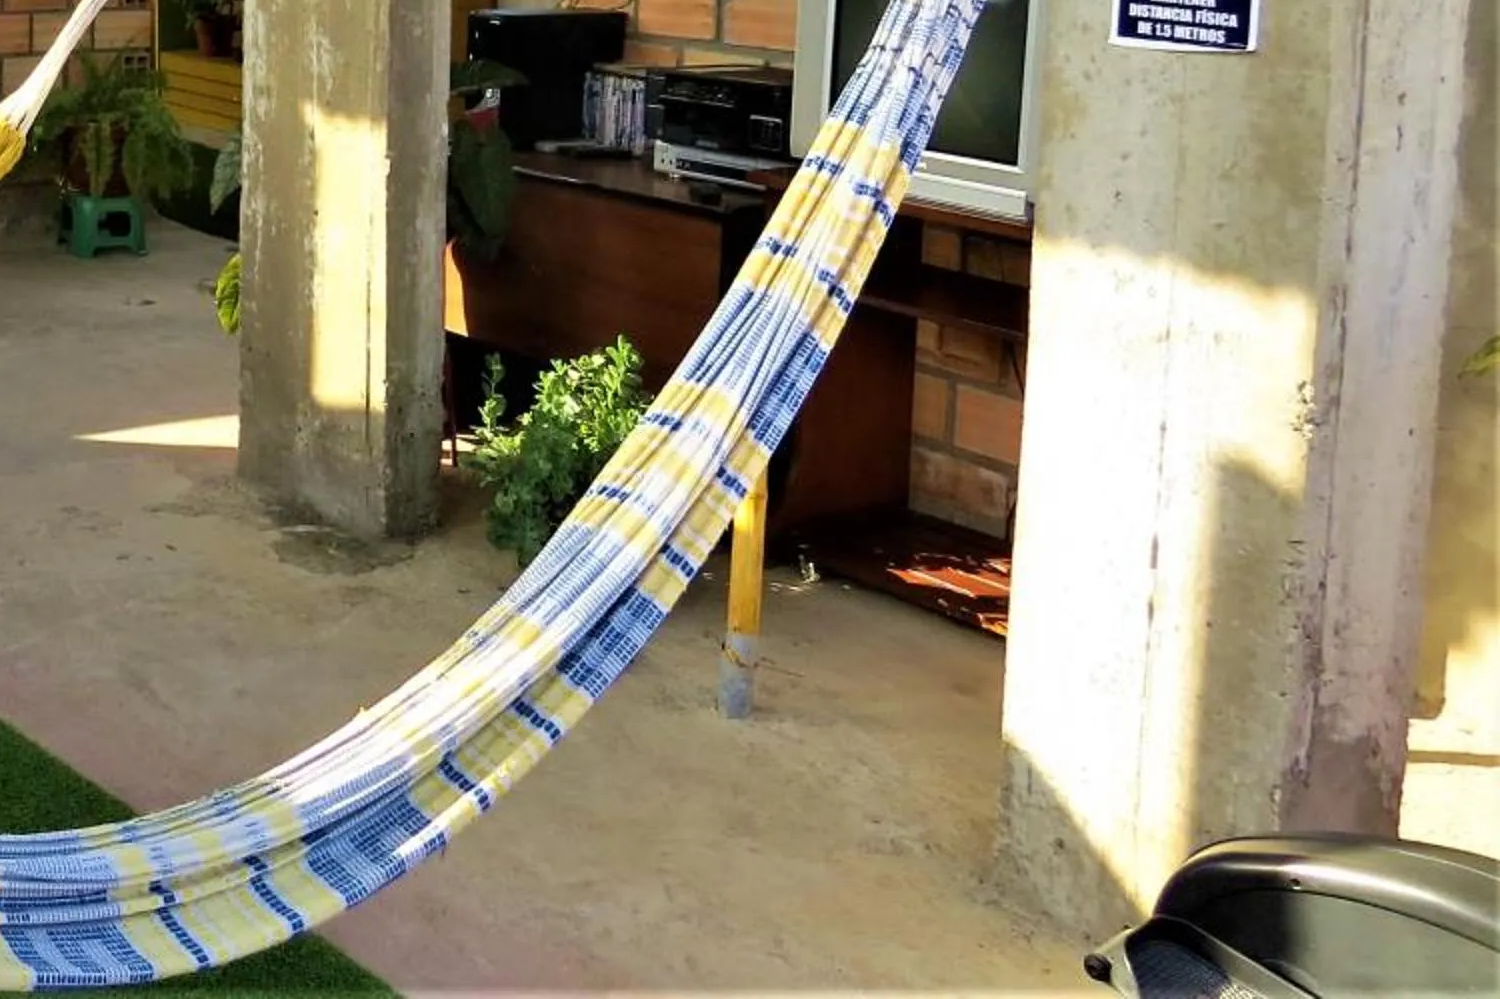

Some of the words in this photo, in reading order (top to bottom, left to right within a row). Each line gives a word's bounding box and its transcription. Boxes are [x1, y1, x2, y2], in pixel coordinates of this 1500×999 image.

[1129, 2, 1192, 23] DISTANCIA
[1137, 21, 1153, 35] DE
[1174, 25, 1226, 43] METROS
